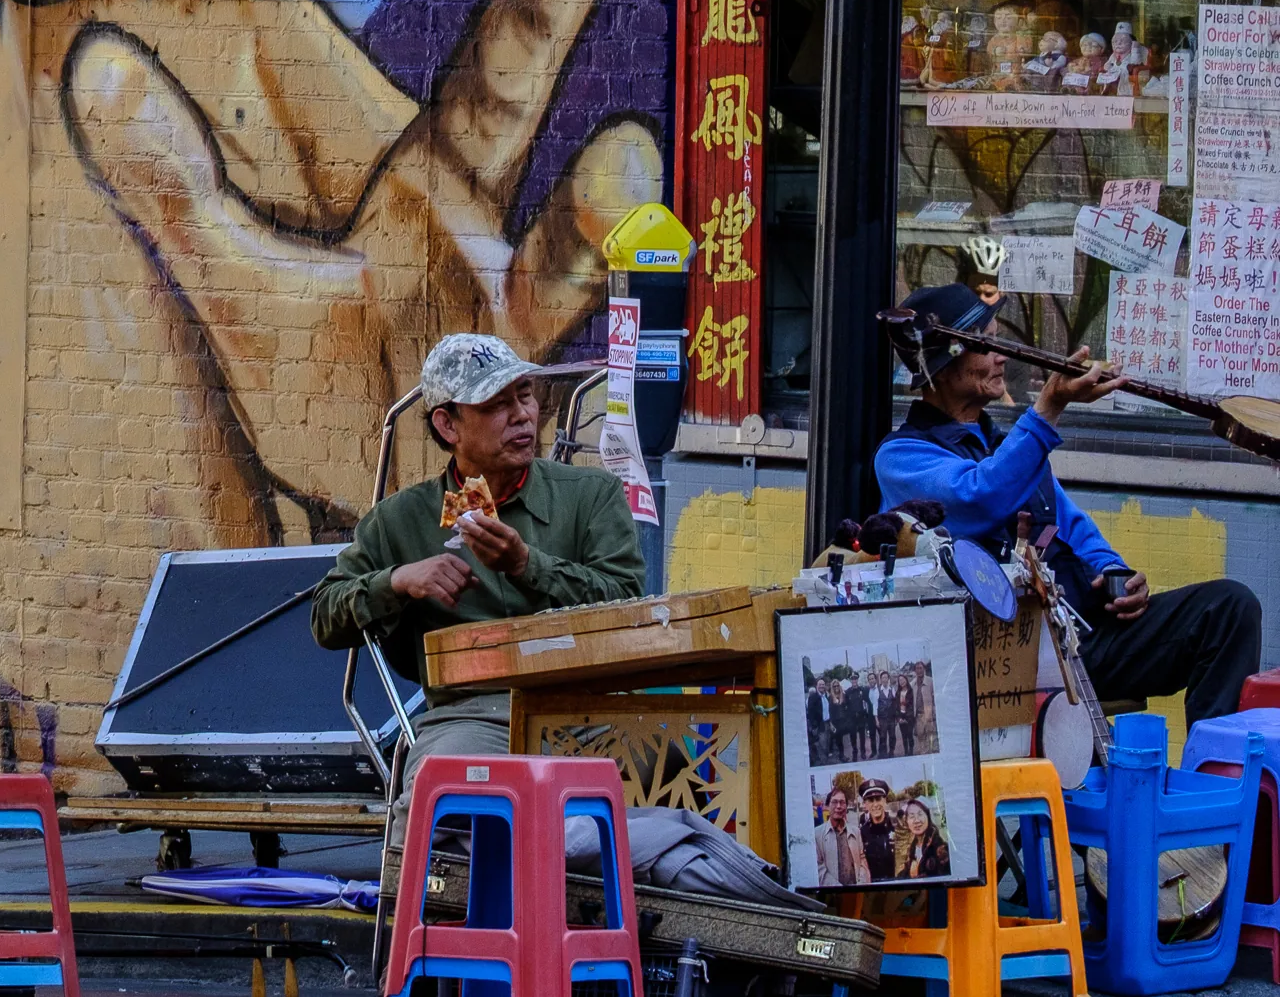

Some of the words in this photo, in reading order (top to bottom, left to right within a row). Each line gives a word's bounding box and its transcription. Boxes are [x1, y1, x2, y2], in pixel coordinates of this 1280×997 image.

[1204, 9, 1244, 24] Please
[1247, 10, 1270, 25] Call
[1207, 27, 1241, 43] Order
[1244, 28, 1265, 43] For
[1202, 45, 1243, 60] Holiday's
[1204, 58, 1256, 75] Strawberry
[1204, 73, 1234, 86] Coffee
[1236, 74, 1272, 88] Crunch
[930, 94, 957, 117] 80%
[963, 99, 977, 113] off
[985, 96, 1019, 112] Marked
[1022, 99, 1046, 112] Down
[1104, 105, 1131, 117] Items
[985, 115, 1009, 127] Already
[1014, 114, 1057, 126] Discounted
[1197, 125, 1218, 135] Coffee
[1220, 127, 1245, 137] Crunch
[1197, 137, 1233, 149] Strawberry
[1197, 148, 1216, 157] Mixed
[1217, 149, 1233, 159] Fruit
[1196, 159, 1229, 170] Chocolate
[1003, 239, 1031, 249] Custard
[1033, 237, 1044, 249] Pie
[1028, 252, 1048, 263] Apple
[1052, 251, 1064, 261] Pie
[1213, 294, 1246, 310] Order
[1249, 296, 1270, 312] The
[1195, 310, 1231, 324] Eastern
[1234, 312, 1269, 329] Bakery
[1192, 323, 1222, 337] Coffee
[1224, 325, 1262, 340] Crunch
[1192, 337, 1212, 352] For
[1214, 339, 1264, 356] Mother's
[609, 348, 633, 365] STOPPING
[1198, 354, 1219, 369] For
[1220, 355, 1248, 371] Your
[1225, 372, 1255, 388] Here!
[976, 656, 1011, 679] NK'S
[977, 685, 1022, 711] ATION
